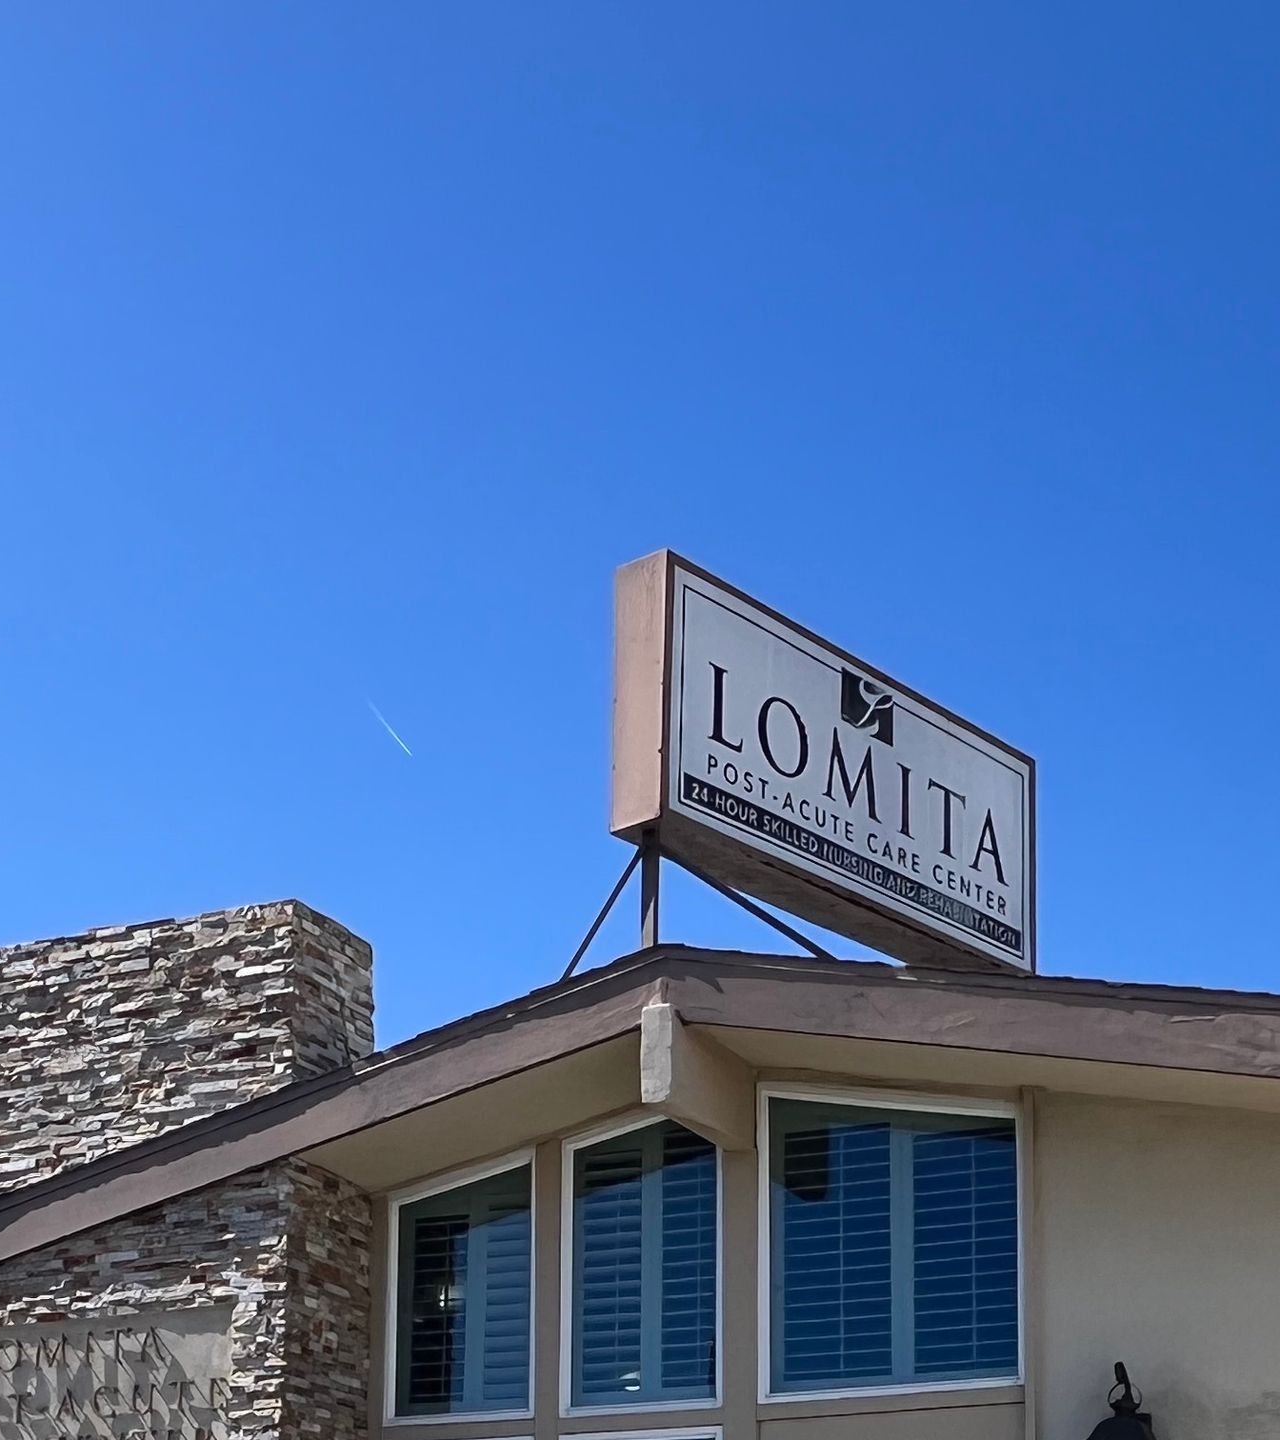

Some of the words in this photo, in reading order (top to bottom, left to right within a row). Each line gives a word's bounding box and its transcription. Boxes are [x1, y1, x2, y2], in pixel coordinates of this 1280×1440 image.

[707, 661, 1010, 887] LOMITA
[707, 753, 854, 842] POST-ACUTE
[867, 833, 920, 873] CARE
[932, 864, 1007, 916] CENTER
[763, 815, 818, 853] SKILLED
[823, 843, 884, 883] NURSING
[886, 874, 918, 897] AND
